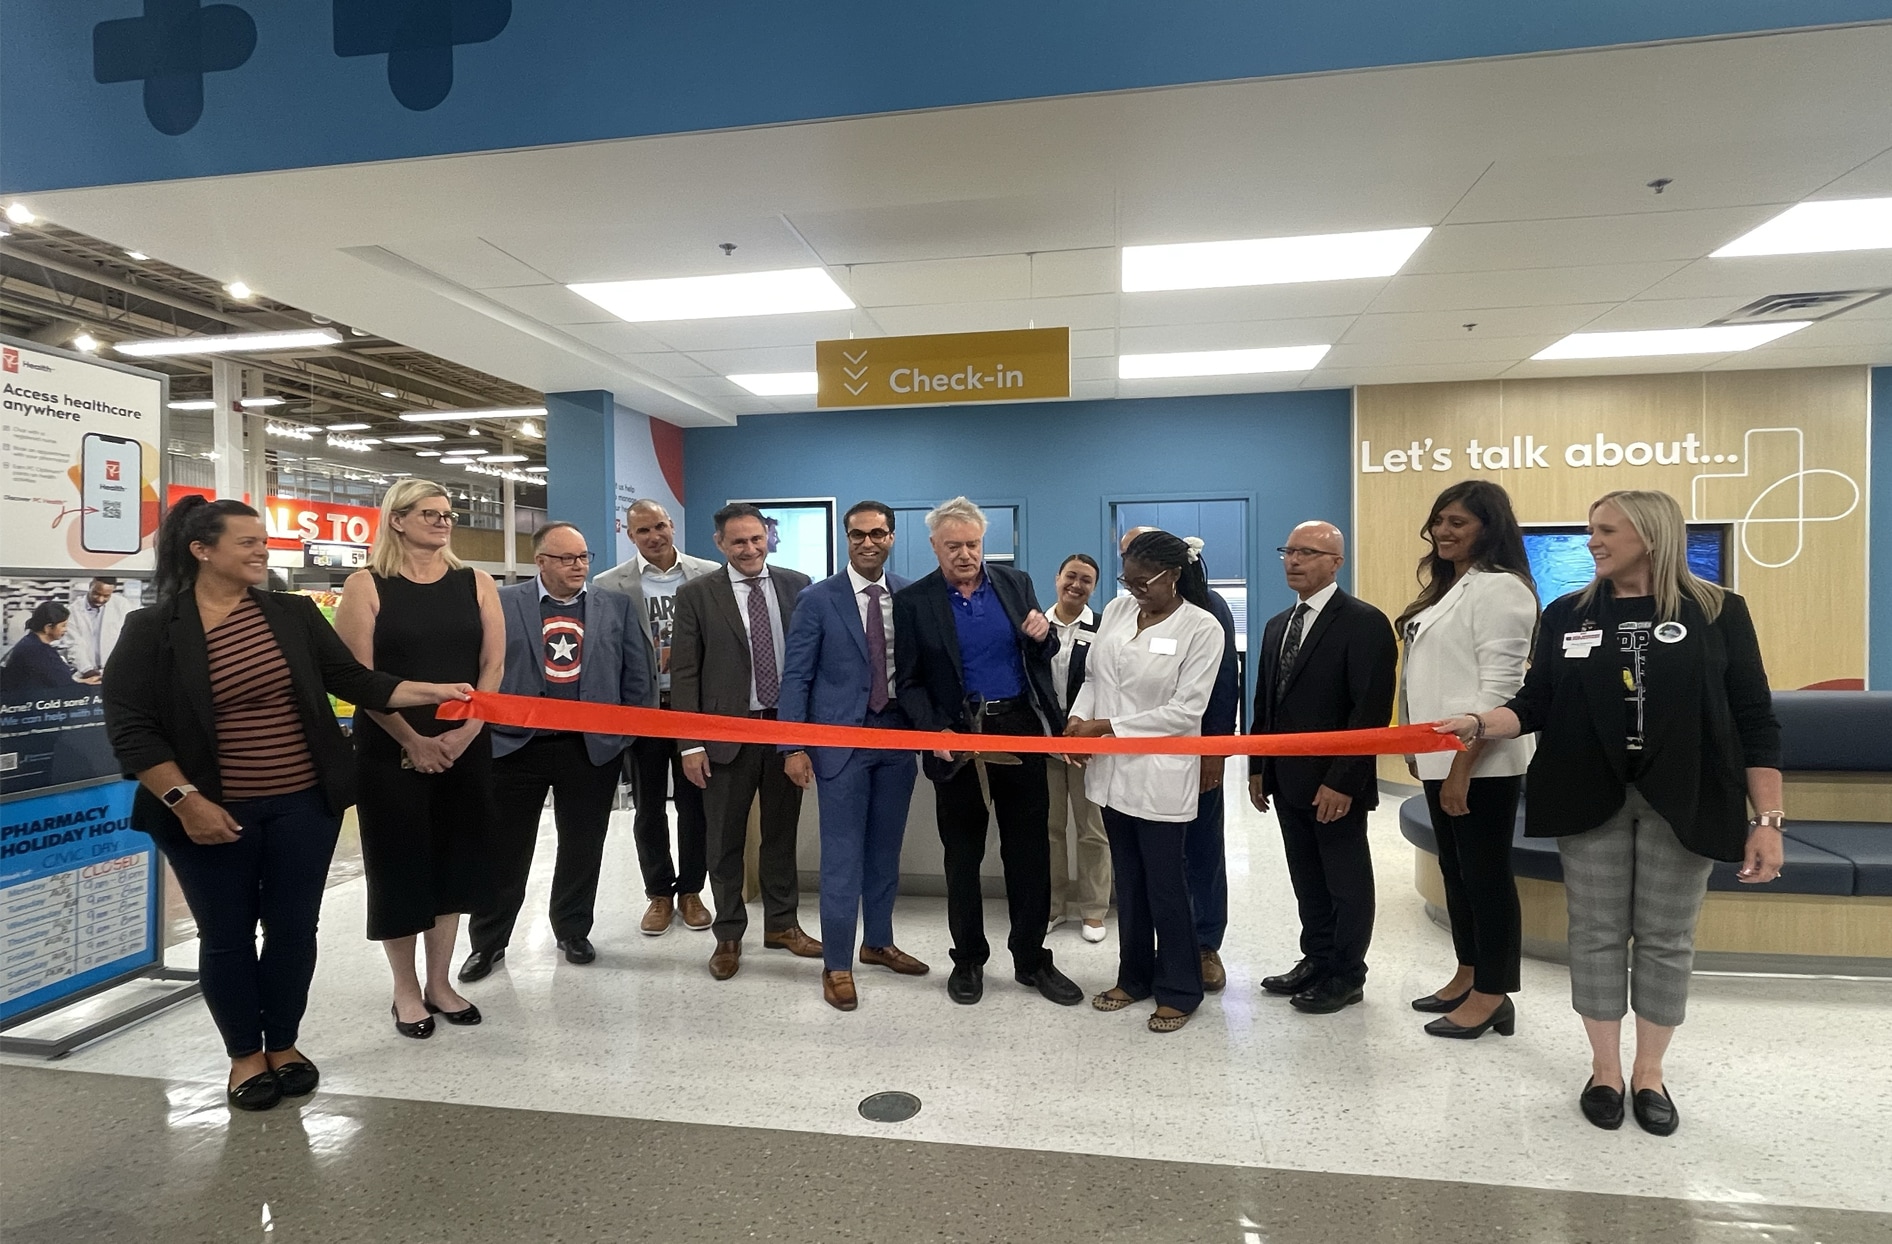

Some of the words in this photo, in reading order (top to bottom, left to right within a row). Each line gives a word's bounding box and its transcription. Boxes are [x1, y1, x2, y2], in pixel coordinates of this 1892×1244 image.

[889, 364, 1023, 394] Check-in
[3, 383, 59, 404] Access
[64, 394, 142, 420] healthcare
[3, 400, 81, 422] anywhere
[1466, 434, 1550, 470] talk
[1564, 432, 1739, 468] about...
[266, 506, 320, 541] ALS
[326, 513, 370, 543] TO
[36, 699, 61, 711] Cold
[44, 711, 68, 722] help
[1, 804, 110, 841] PHARMACY
[0, 826, 86, 860] HOLIDAY
[88, 816, 131, 838] HOU
[42, 848, 84, 869] CIVIC
[92, 840, 119, 858] DAY
[82, 854, 140, 879] CLOSED
[8, 883, 46, 898] Monday
[7, 898, 47, 913] Tuesday
[7, 910, 62, 930] Wednesday
[8, 929, 50, 947] Thursday
[7, 948, 37, 963] Friday
[7, 960, 50, 980] Saturday
[8, 979, 42, 996] Sunday
